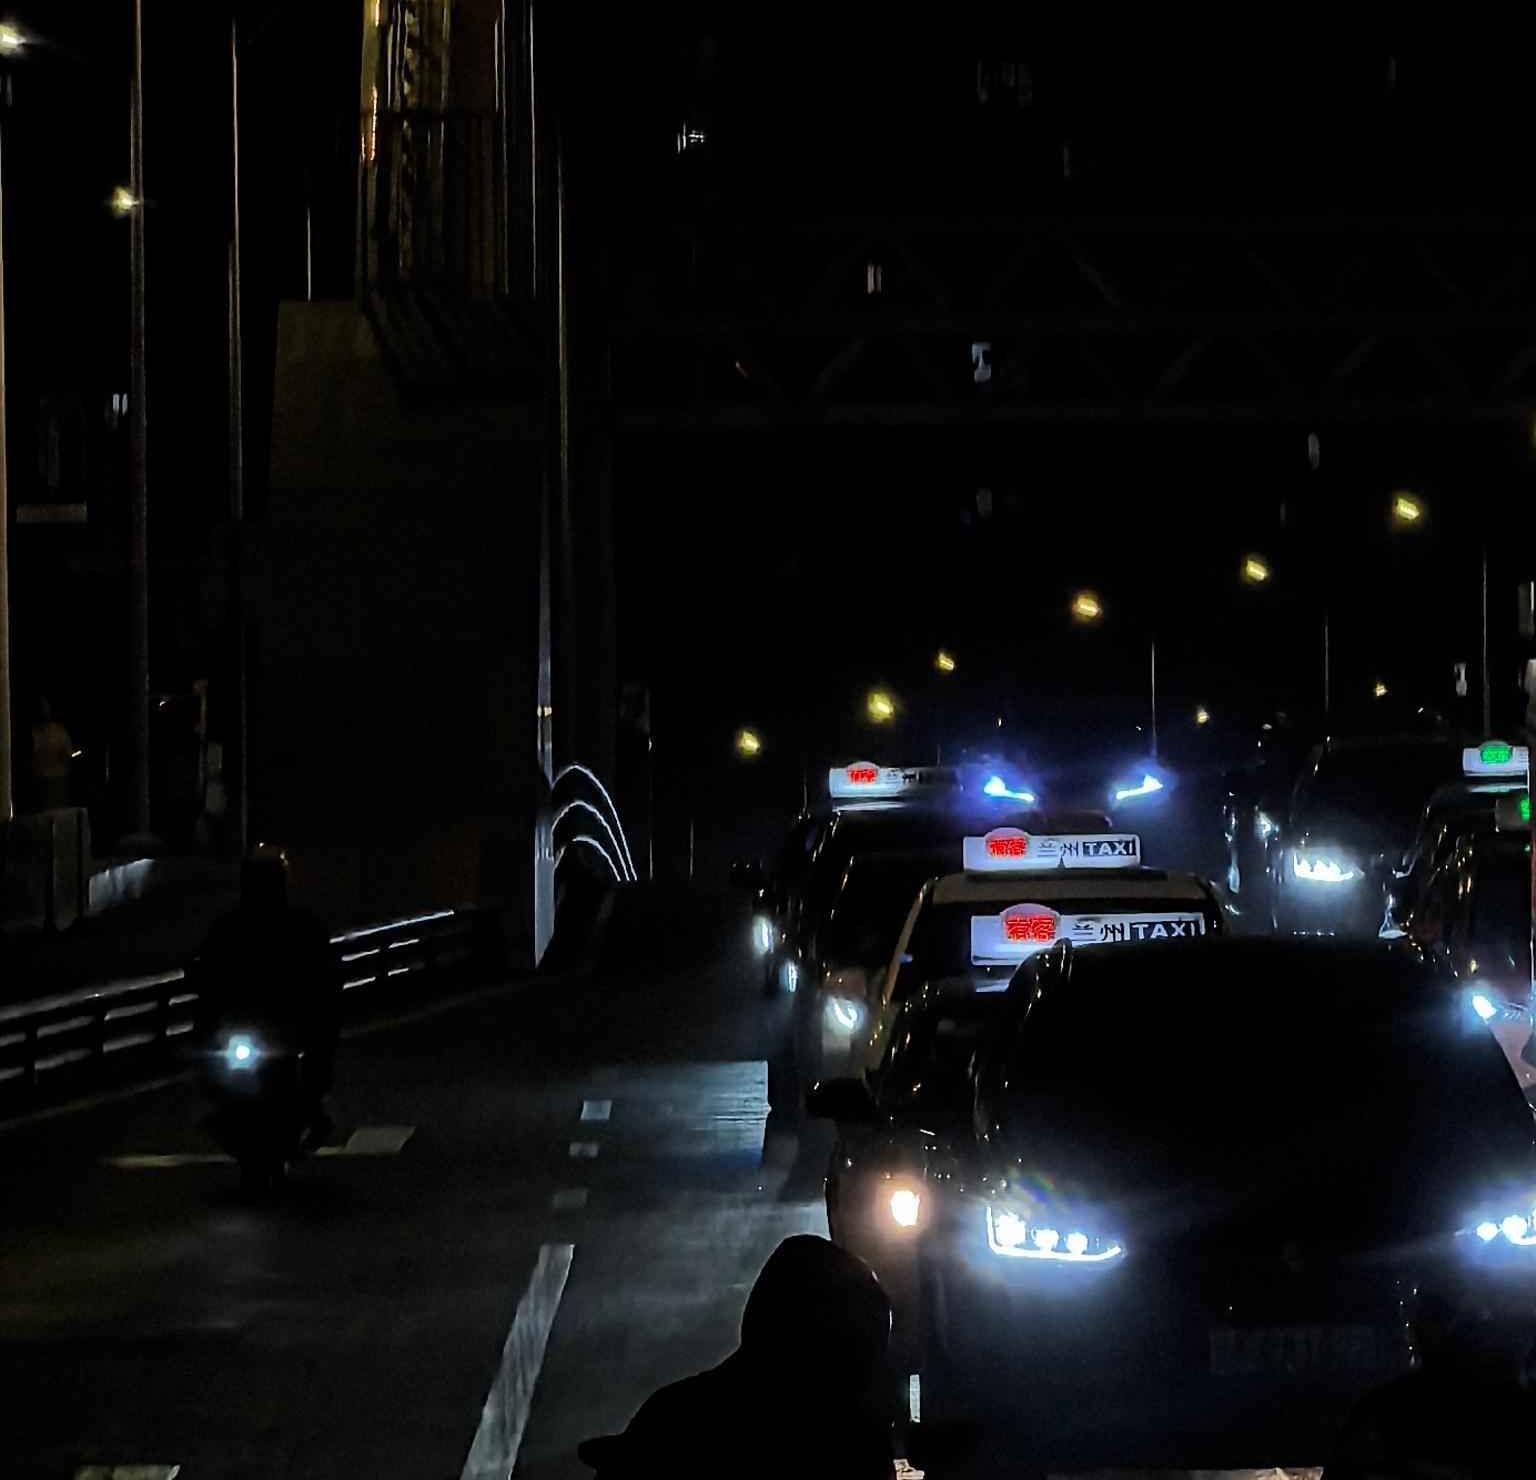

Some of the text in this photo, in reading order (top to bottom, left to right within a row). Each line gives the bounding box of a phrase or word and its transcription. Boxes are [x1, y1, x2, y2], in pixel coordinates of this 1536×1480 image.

[987, 838, 1134, 859] 有客 兰州 TAXI
[1004, 916, 1197, 943] 有客 兰州 TAXI
